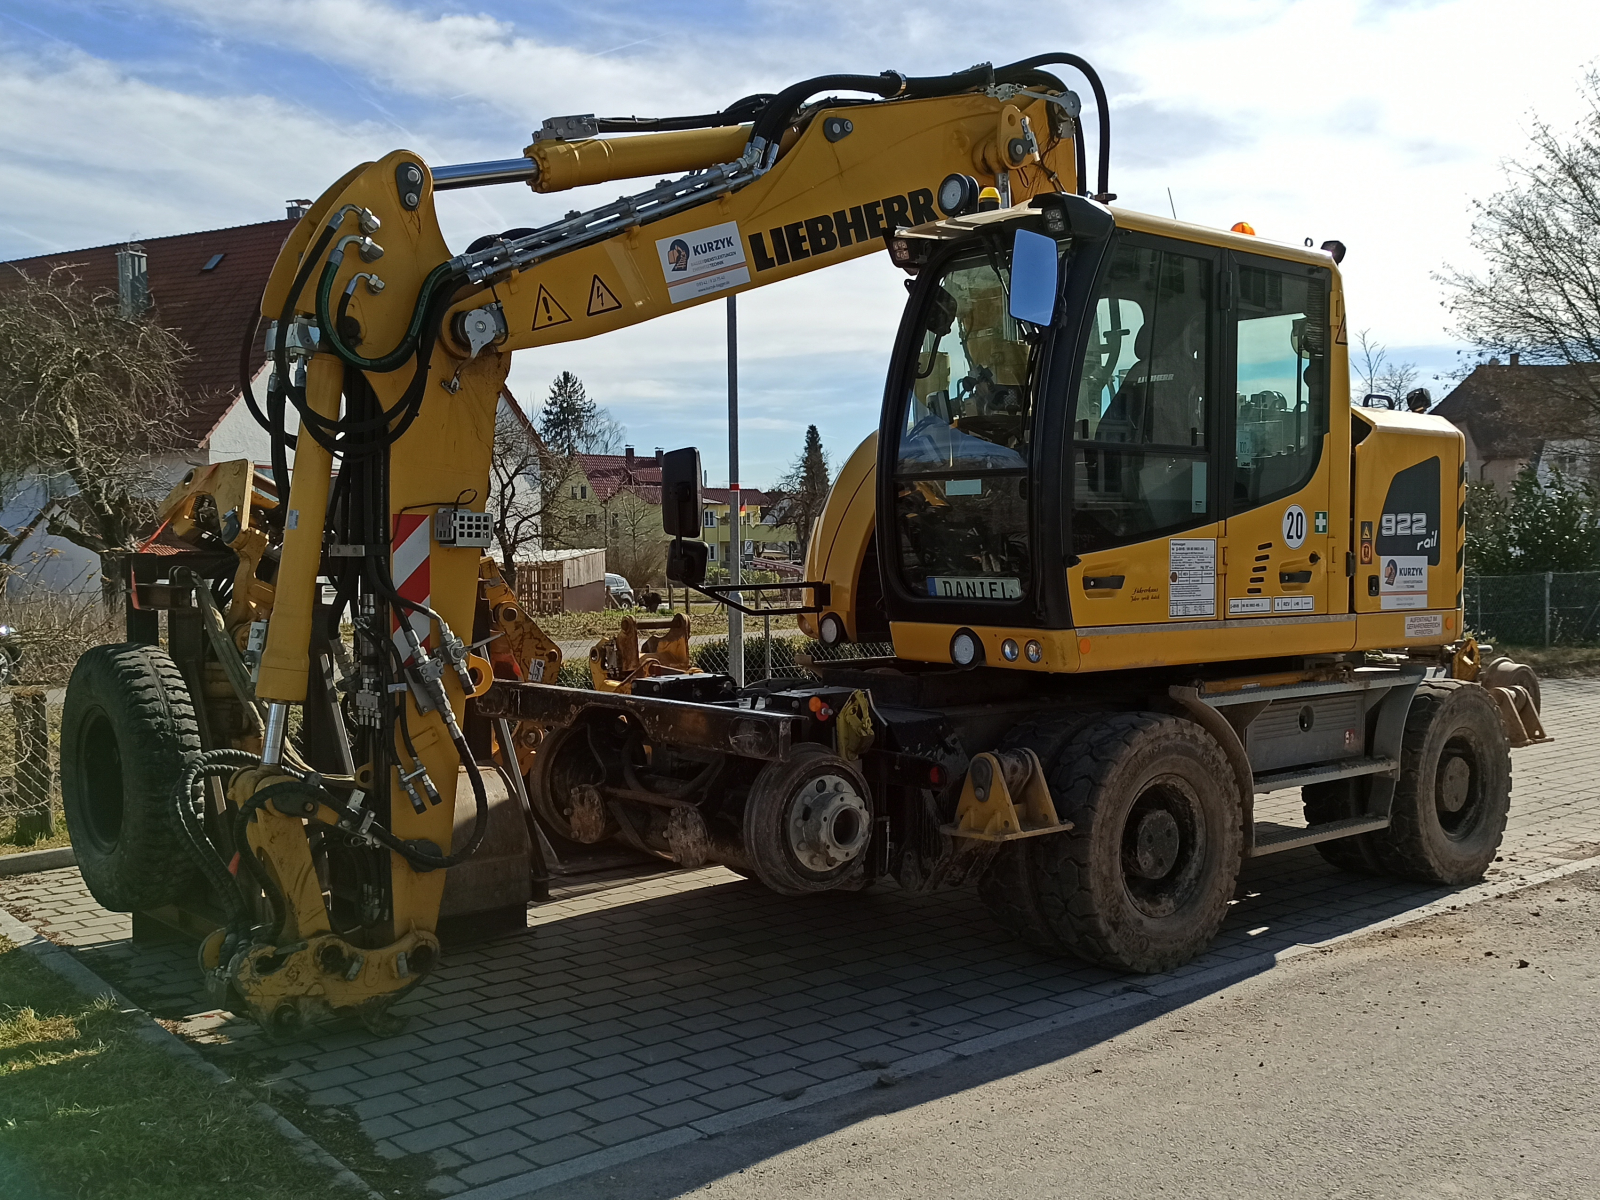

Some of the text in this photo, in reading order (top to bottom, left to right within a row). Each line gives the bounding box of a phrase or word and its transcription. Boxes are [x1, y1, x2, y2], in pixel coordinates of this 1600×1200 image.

[748, 188, 939, 272] LIEBHERR
[693, 236, 734, 256] KURZYK
[1286, 511, 1303, 540] 20
[1381, 512, 1427, 537] 922
[1416, 530, 1438, 551] rail
[1399, 567, 1423, 577] KURZYK
